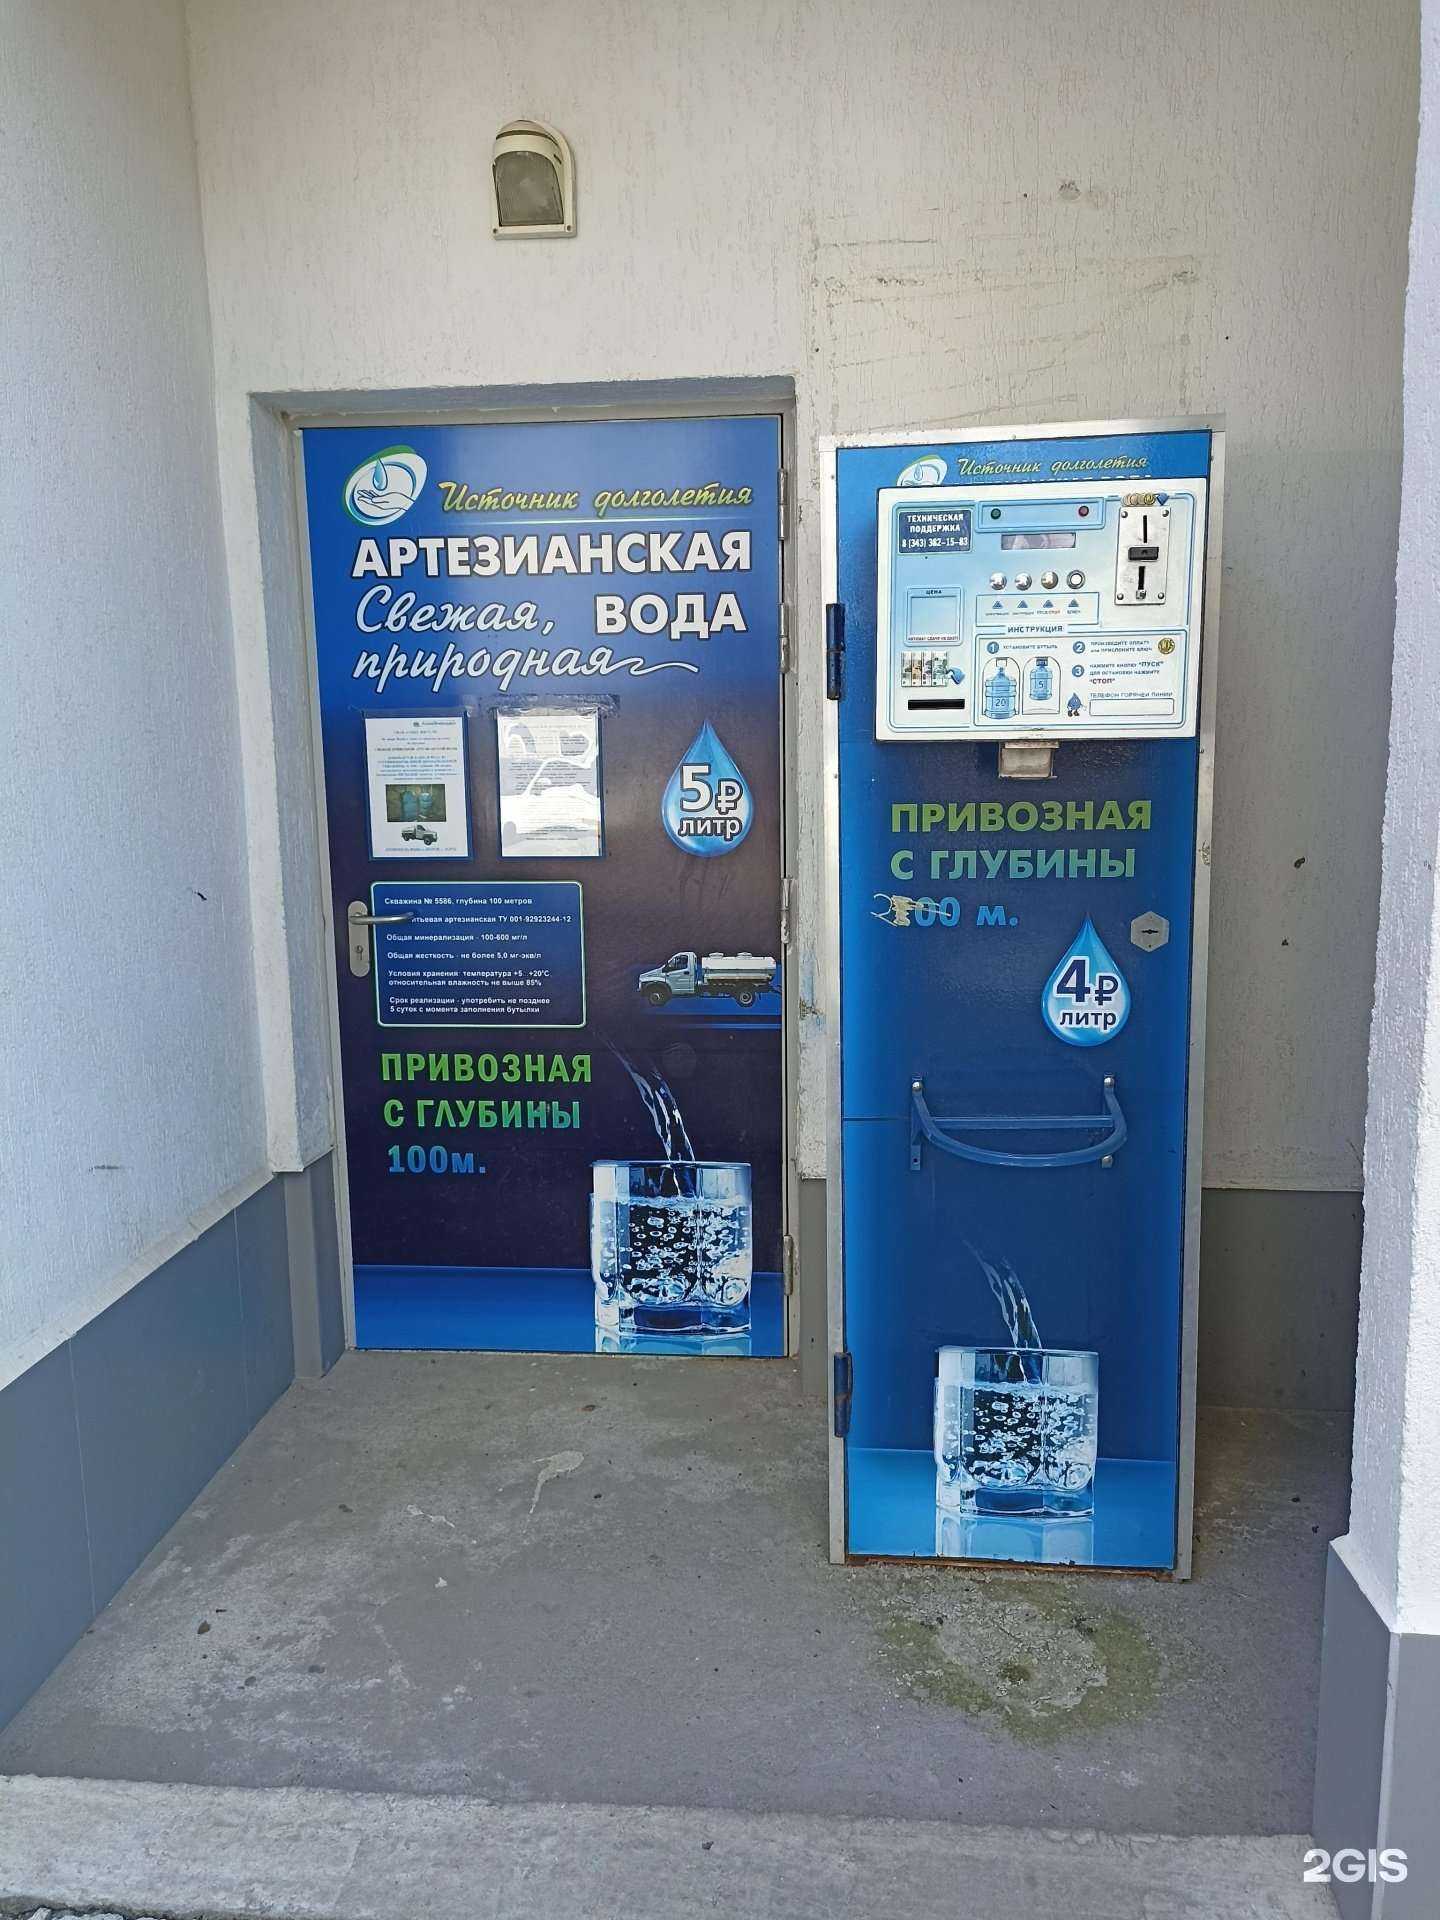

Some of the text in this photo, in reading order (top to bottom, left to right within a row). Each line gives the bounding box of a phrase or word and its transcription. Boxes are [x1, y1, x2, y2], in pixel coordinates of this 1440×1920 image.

[958, 454, 1148, 476] Источник долголетия
[438, 482, 753, 518] Источник долголетия
[907, 513, 964, 523] ТЕХНИЧЕСКАЯ
[909, 524, 961, 534] ПОДДЕРЖКА
[352, 530, 751, 578] АРТЕЗИАНСКАЯ
[356, 584, 556, 635] Свежая,
[595, 593, 747, 640] ВОДА
[1007, 625, 1064, 634] ИНСТРУКЦИЯ
[352, 641, 698, 693] природная
[995, 698, 1007, 707] 20
[890, 800, 1152, 833] ПРИВОЗНАЯ
[679, 816, 743, 841] литр
[890, 848, 1136, 881] С ГЛУБИНЫ
[384, 897, 422, 905] Скважина
[423, 897, 433, 905] №
[456, 897, 487, 906] глубина
[489, 897, 502, 905] 100
[504, 898, 533, 906] метров
[498, 915, 508, 923] ТУ
[976, 904, 1019, 928] м.
[386, 933, 413, 942] Общая
[387, 951, 414, 960] Общая
[471, 951, 494, 959] более
[496, 952, 508, 960] 5,0
[389, 996, 408, 1005] Срок
[461, 997, 506, 1006] употребить
[506, 1006, 540, 1014] бутылки
[1058, 1010, 1118, 1031] литр
[381, 1053, 592, 1083] ПРИВОЗНАЯ
[383, 1099, 581, 1129] С ГЛУБИНЫ
[388, 1145, 486, 1174] 100м.
